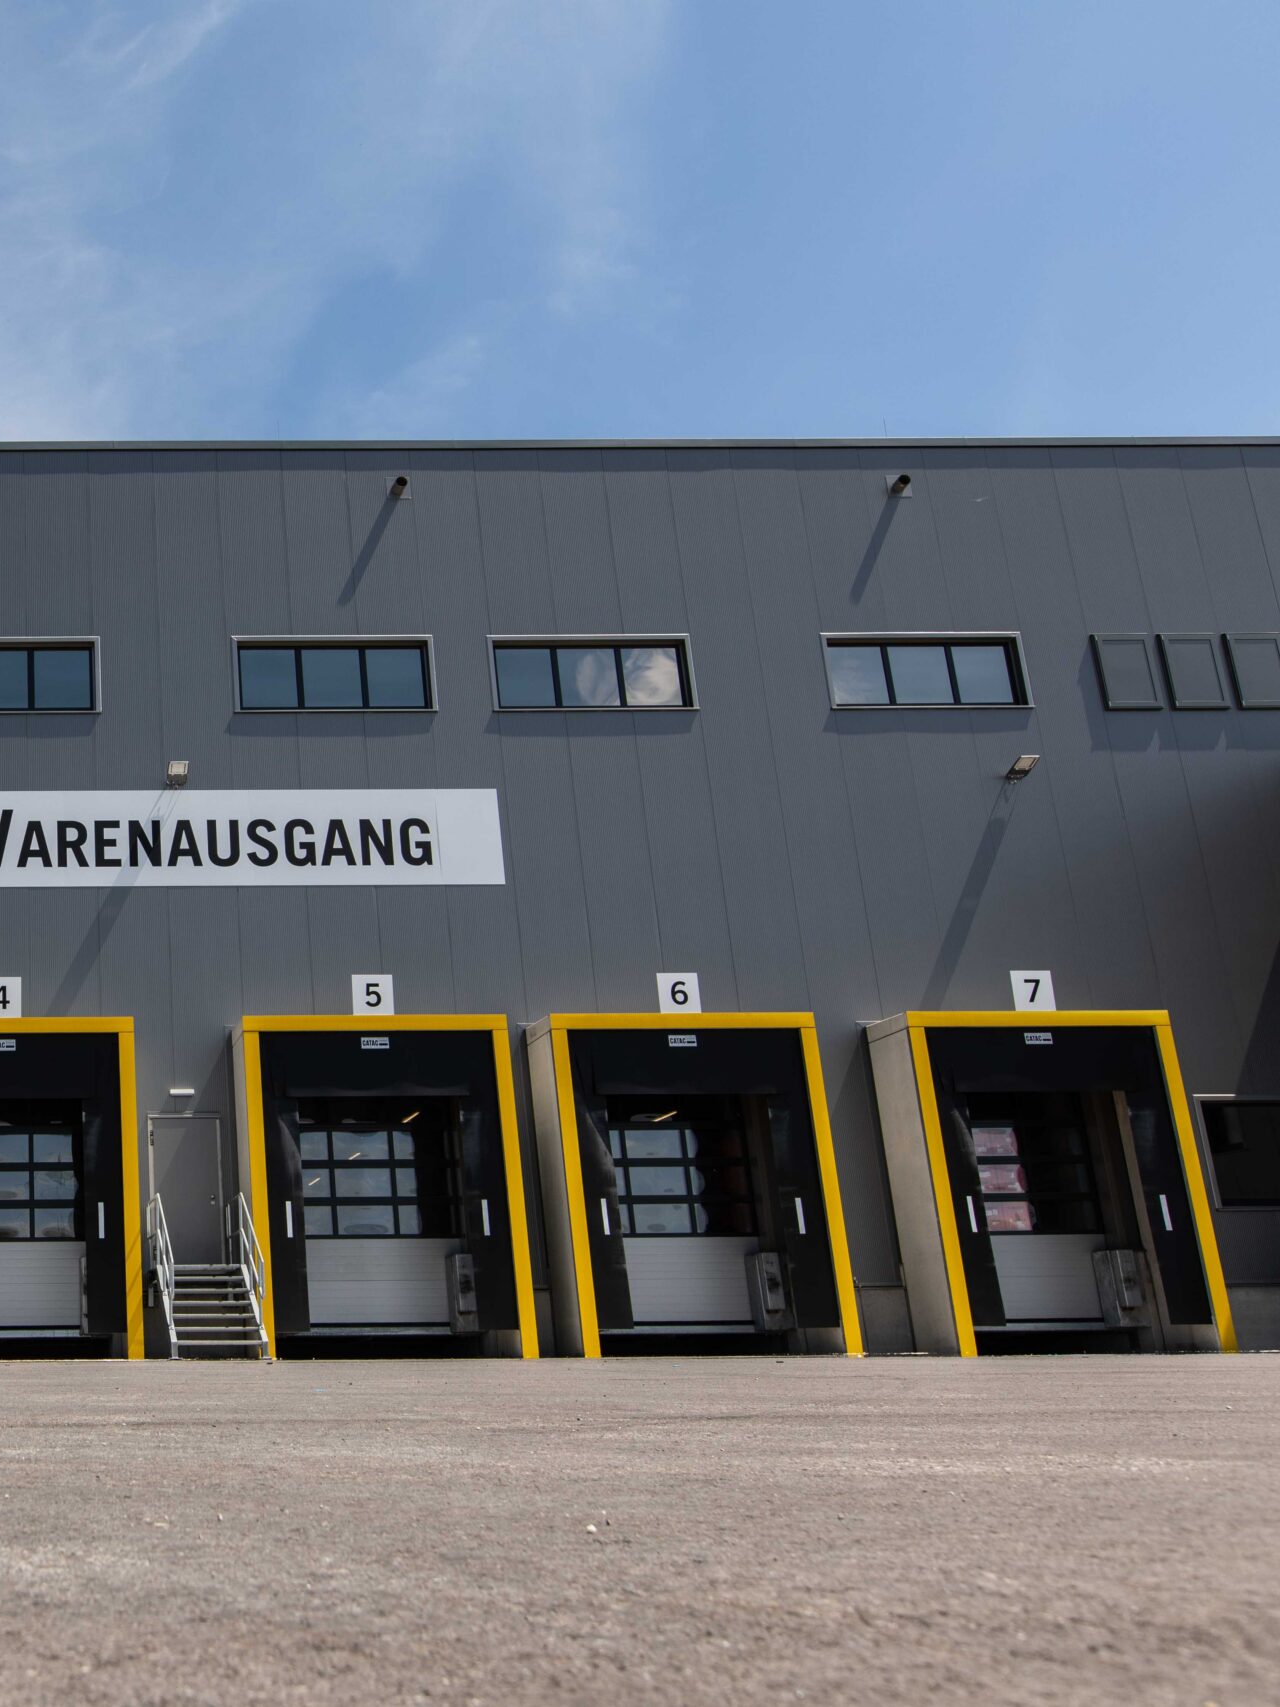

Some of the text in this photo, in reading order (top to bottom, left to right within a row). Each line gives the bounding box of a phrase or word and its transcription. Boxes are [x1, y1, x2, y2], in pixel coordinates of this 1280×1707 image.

[365, 982, 382, 1008] 5
[670, 980, 689, 1006] 6
[1023, 978, 1041, 1003] 7
